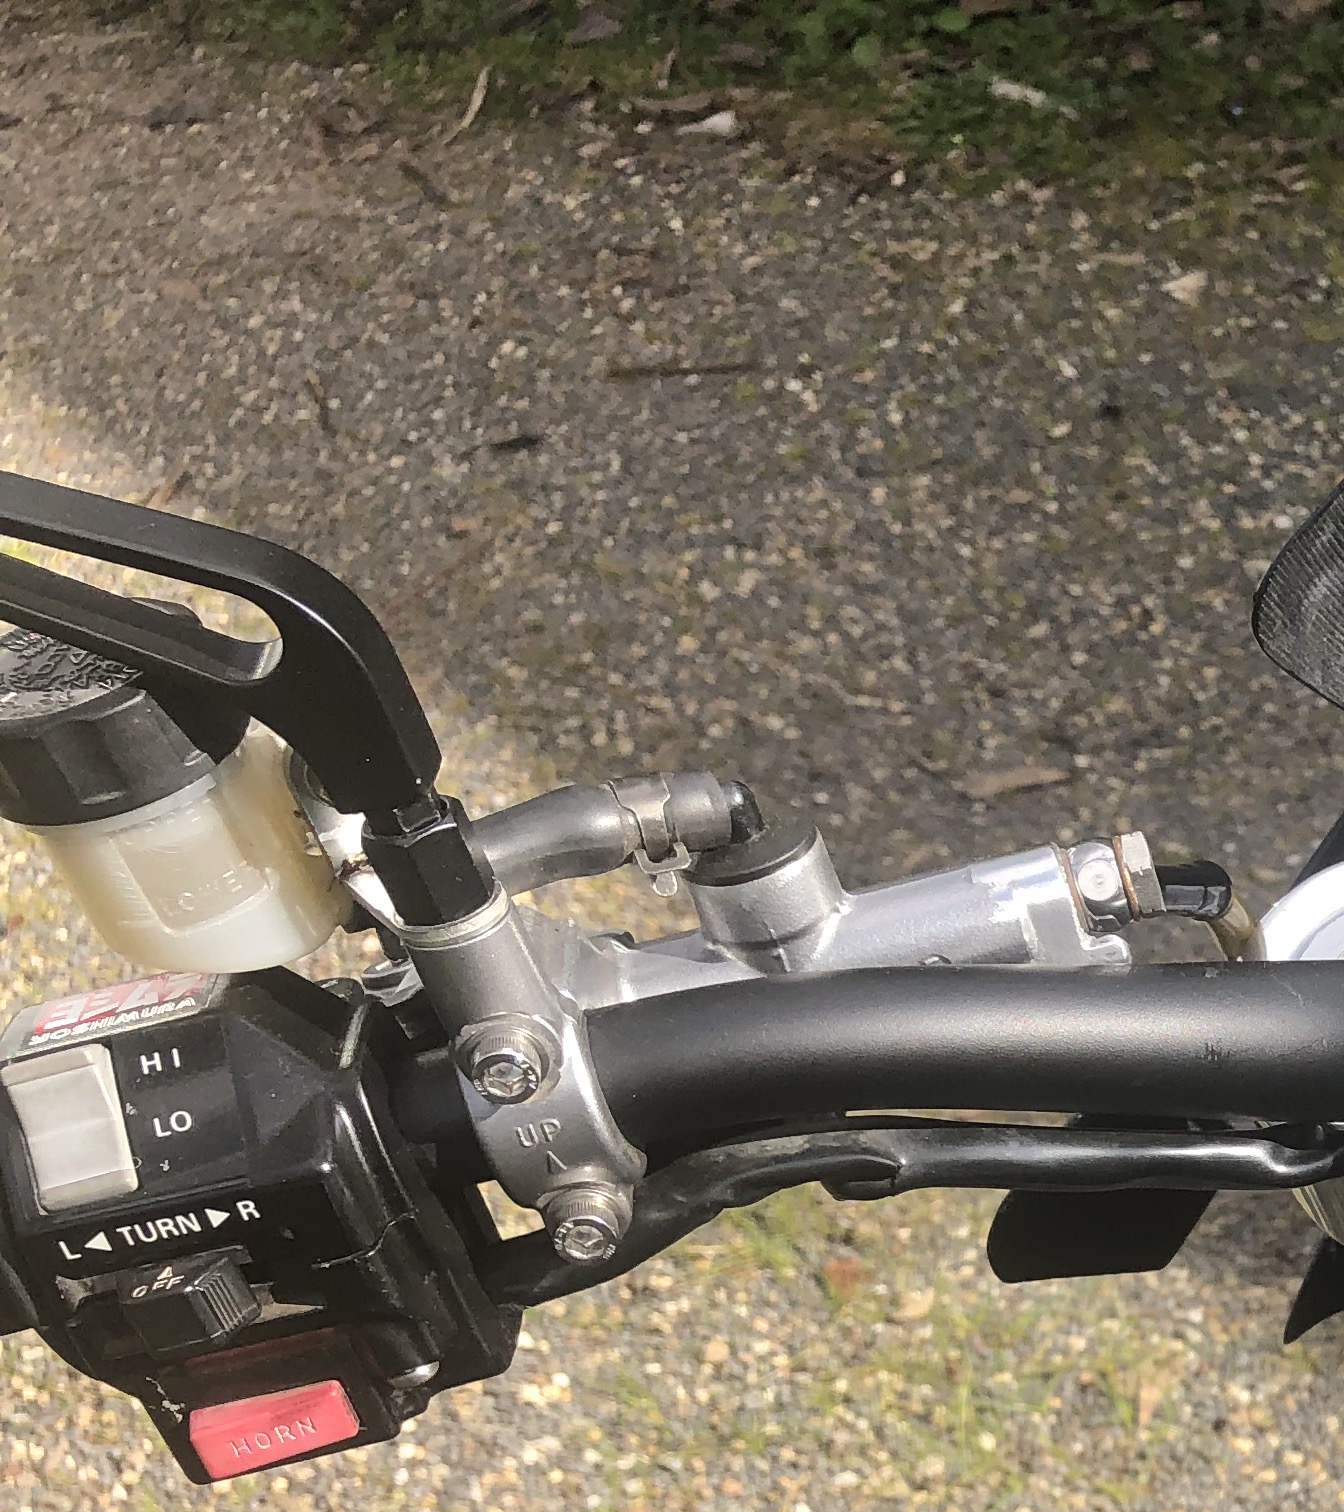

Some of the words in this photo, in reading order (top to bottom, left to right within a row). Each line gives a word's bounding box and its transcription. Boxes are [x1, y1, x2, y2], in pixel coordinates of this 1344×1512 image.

[29, 997, 196, 1046] YOSHIMURA
[139, 1048, 181, 1075] HI
[152, 1110, 193, 1137] LO
[515, 1118, 562, 1148] UP
[58, 1240, 82, 1261] L
[116, 1212, 202, 1247] TURN
[235, 1200, 261, 1221] R
[132, 1273, 185, 1298] OFF
[229, 1416, 317, 1458] HORN
